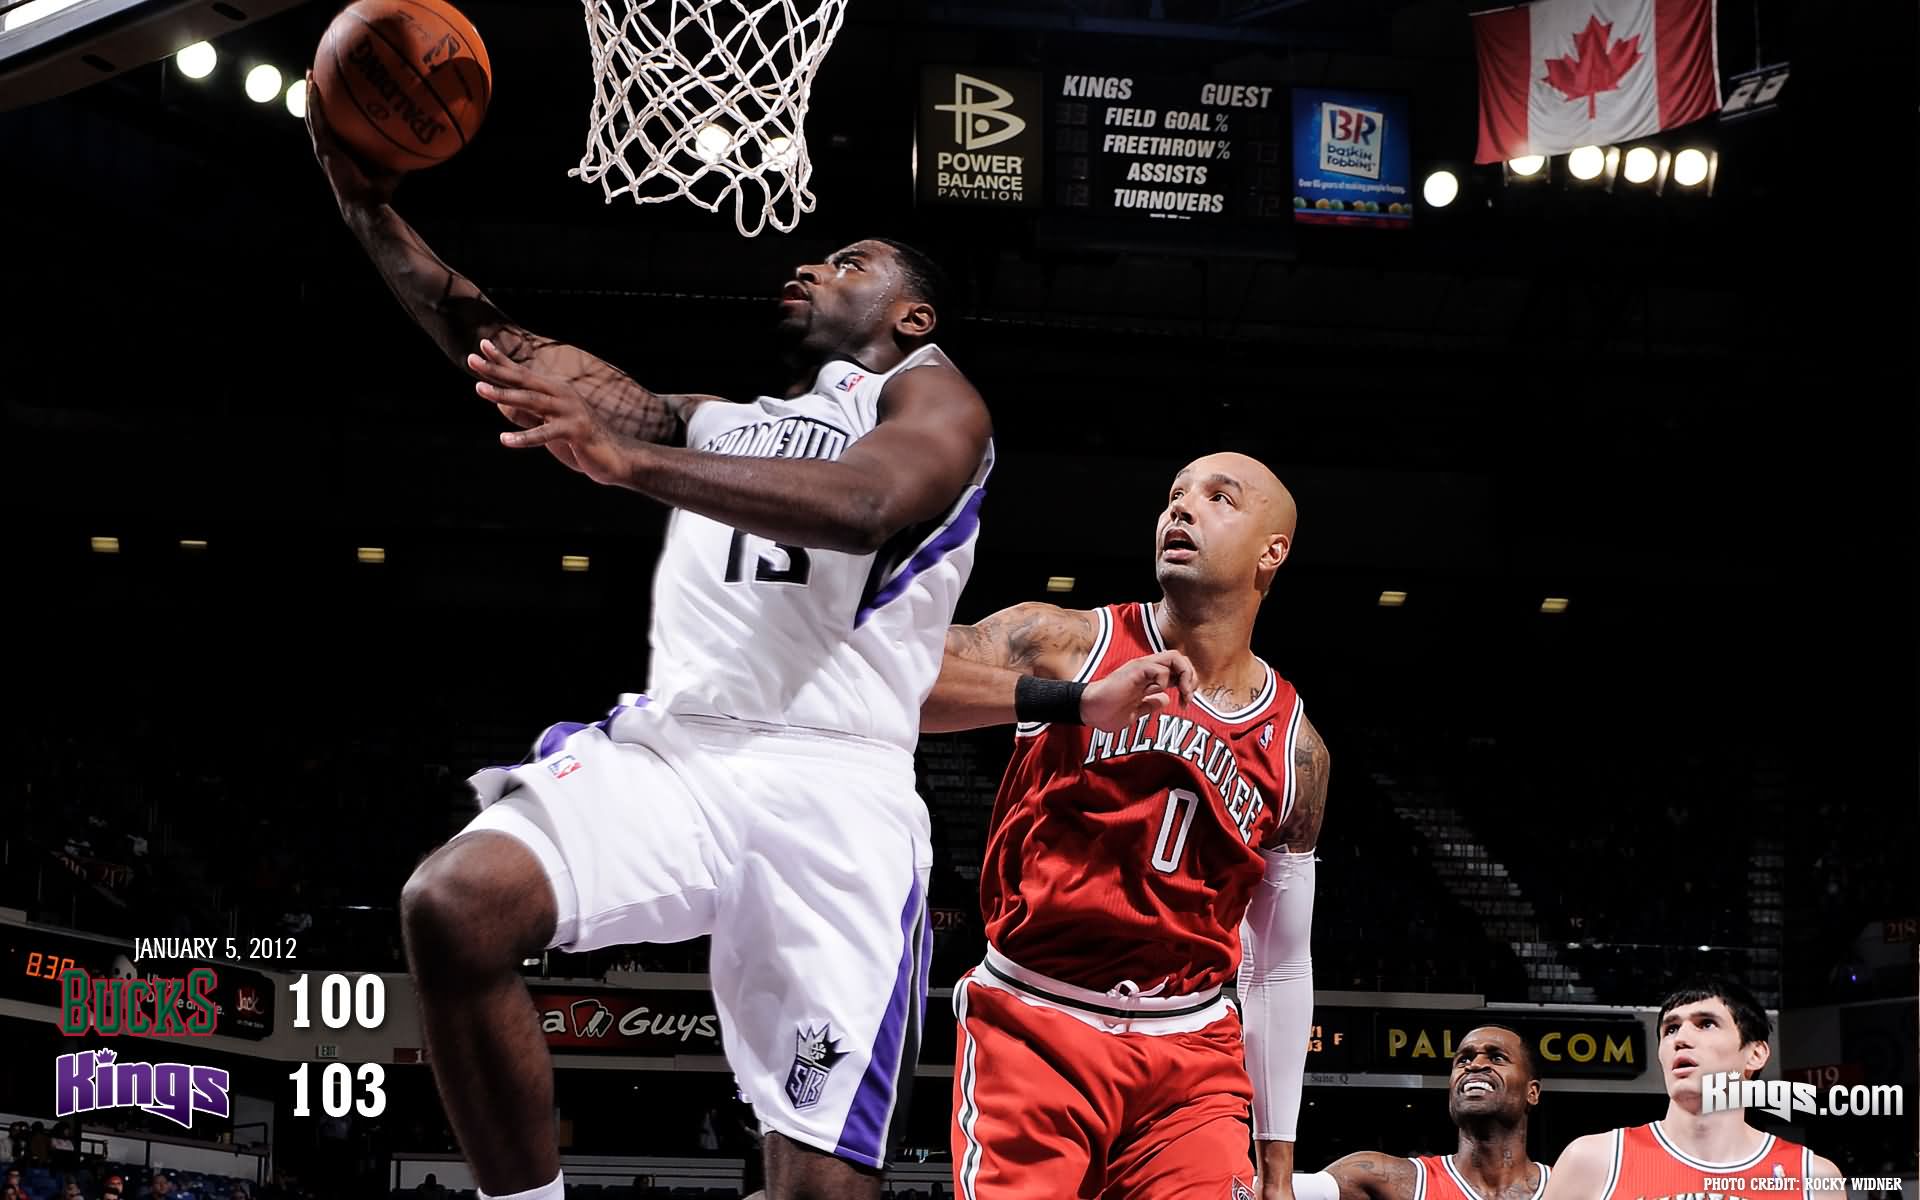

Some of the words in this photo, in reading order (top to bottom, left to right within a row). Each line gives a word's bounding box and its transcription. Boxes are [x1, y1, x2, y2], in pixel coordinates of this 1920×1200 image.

[350, 33, 446, 144] SPALDING
[1062, 75, 1134, 100] KINGS
[1201, 83, 1273, 109] GUEST
[1104, 107, 1158, 128] FIELD
[1164, 110, 1212, 132] GOAL
[1329, 110, 1377, 145] BR
[937, 152, 1023, 174] POWER
[1127, 162, 1208, 185] ASSISTS
[937, 171, 1023, 191] BALANCE
[937, 187, 1023, 201] PAVILION
[1113, 189, 1225, 214] TURNOVERS
[1084, 713, 1264, 845] MILWAUKEE
[1150, 787, 1199, 875] 0
[618, 1006, 717, 1042] Guys
[1388, 1028, 1456, 1058] PAL
